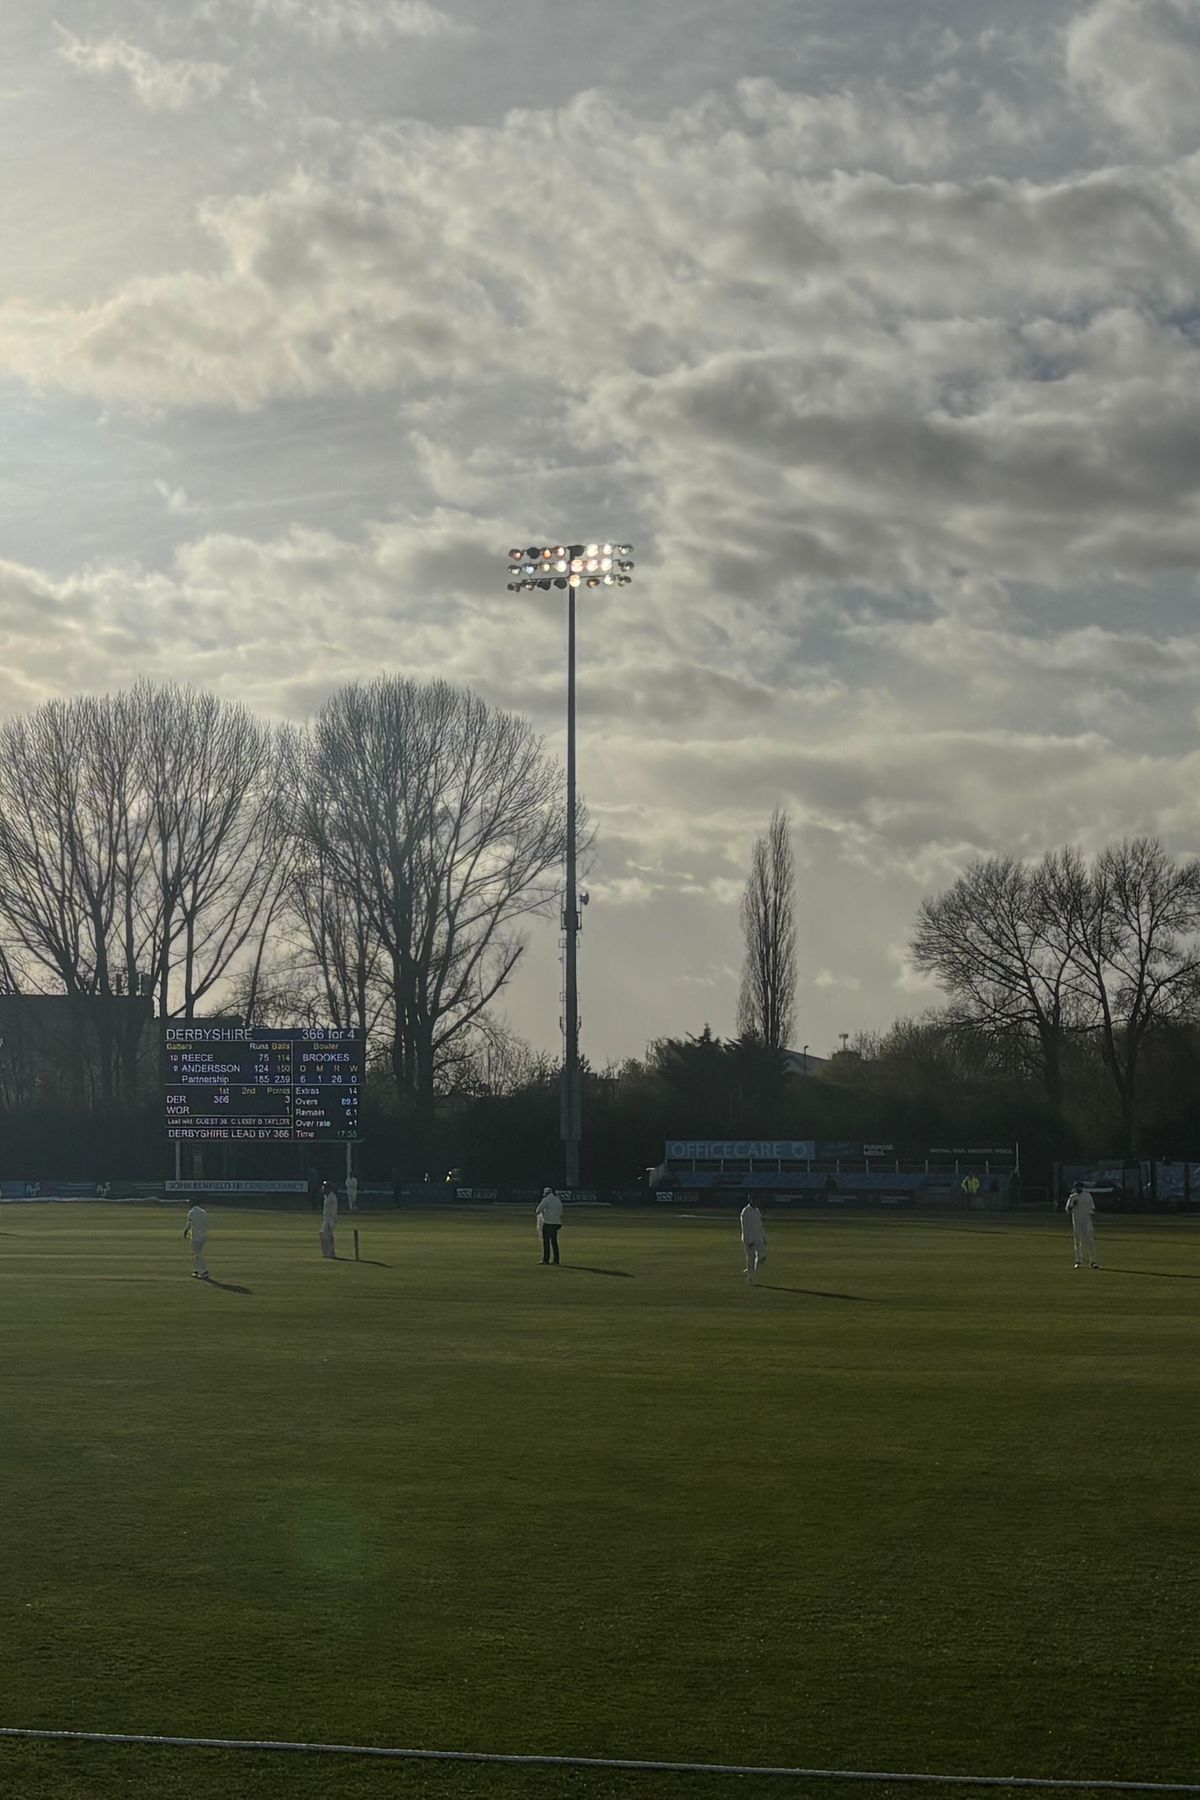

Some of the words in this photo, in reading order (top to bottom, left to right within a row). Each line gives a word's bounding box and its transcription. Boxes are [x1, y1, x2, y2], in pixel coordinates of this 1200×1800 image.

[166, 1028, 253, 1040] DERBYSHIRE
[302, 1028, 325, 1040] 366
[327, 1028, 345, 1040] for
[347, 1028, 355, 1040] 4
[181, 1053, 214, 1062] REECE
[258, 1053, 270, 1062] 75
[302, 1053, 350, 1062] BROOKES
[181, 1064, 241, 1073] ANDERSSON
[254, 1064, 269, 1073] 124
[182, 1074, 230, 1085] Partnership
[350, 1075, 357, 1083] 0
[241, 1087, 256, 1095] 2nd
[267, 1087, 290, 1095] Points
[295, 1087, 320, 1095] Extras
[166, 1095, 186, 1104] DER
[284, 1095, 290, 1104] 3
[295, 1108, 325, 1116] Remain
[295, 1119, 314, 1127] Over
[168, 1129, 229, 1138] DERBYSHIRE
[231, 1129, 256, 1138] LEAD
[258, 1129, 271, 1138] BY
[296, 1129, 315, 1138] Time
[671, 1142, 782, 1158] OFFICECARE
